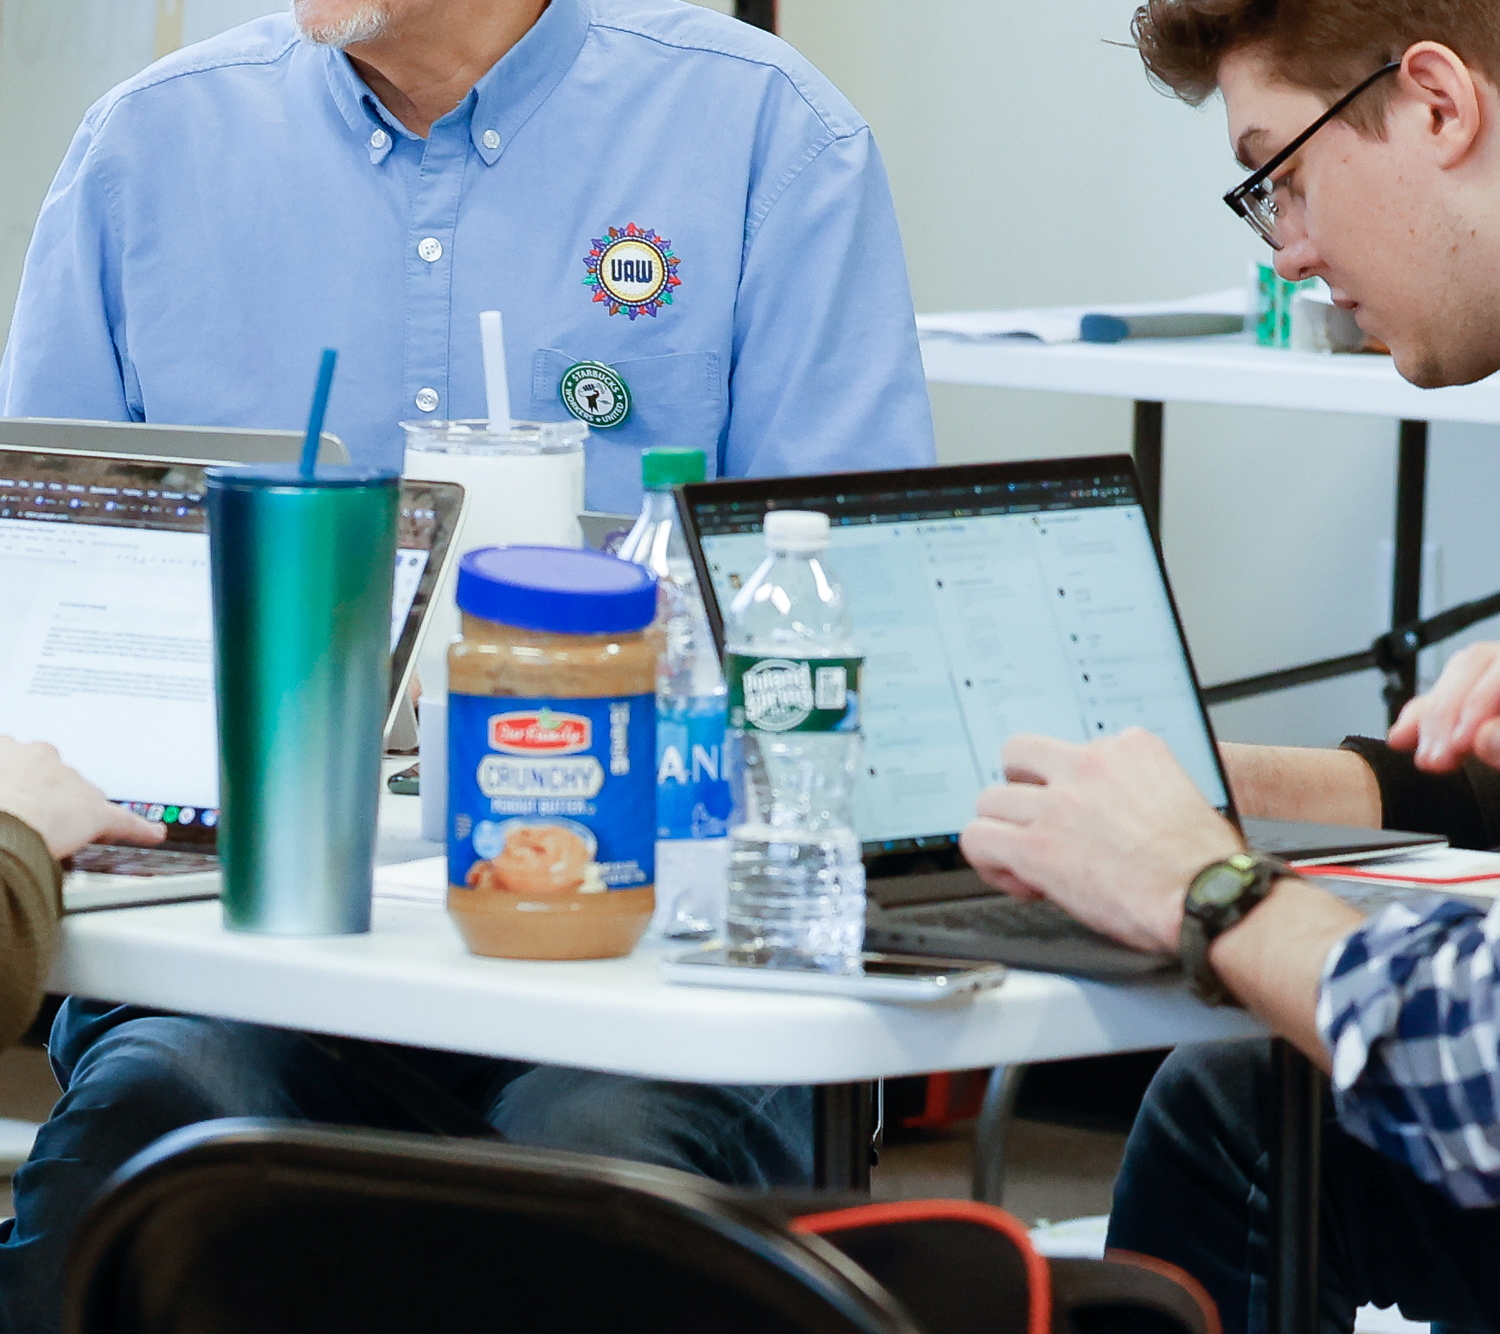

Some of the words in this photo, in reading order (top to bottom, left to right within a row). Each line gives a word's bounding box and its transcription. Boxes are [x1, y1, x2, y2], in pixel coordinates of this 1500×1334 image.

[611, 258, 653, 283] UAW
[571, 368, 620, 394] STARBUCKS
[565, 388, 594, 423] WORKERS
[601, 402, 625, 423] UNITED
[487, 764, 594, 788] CRUNCHY
